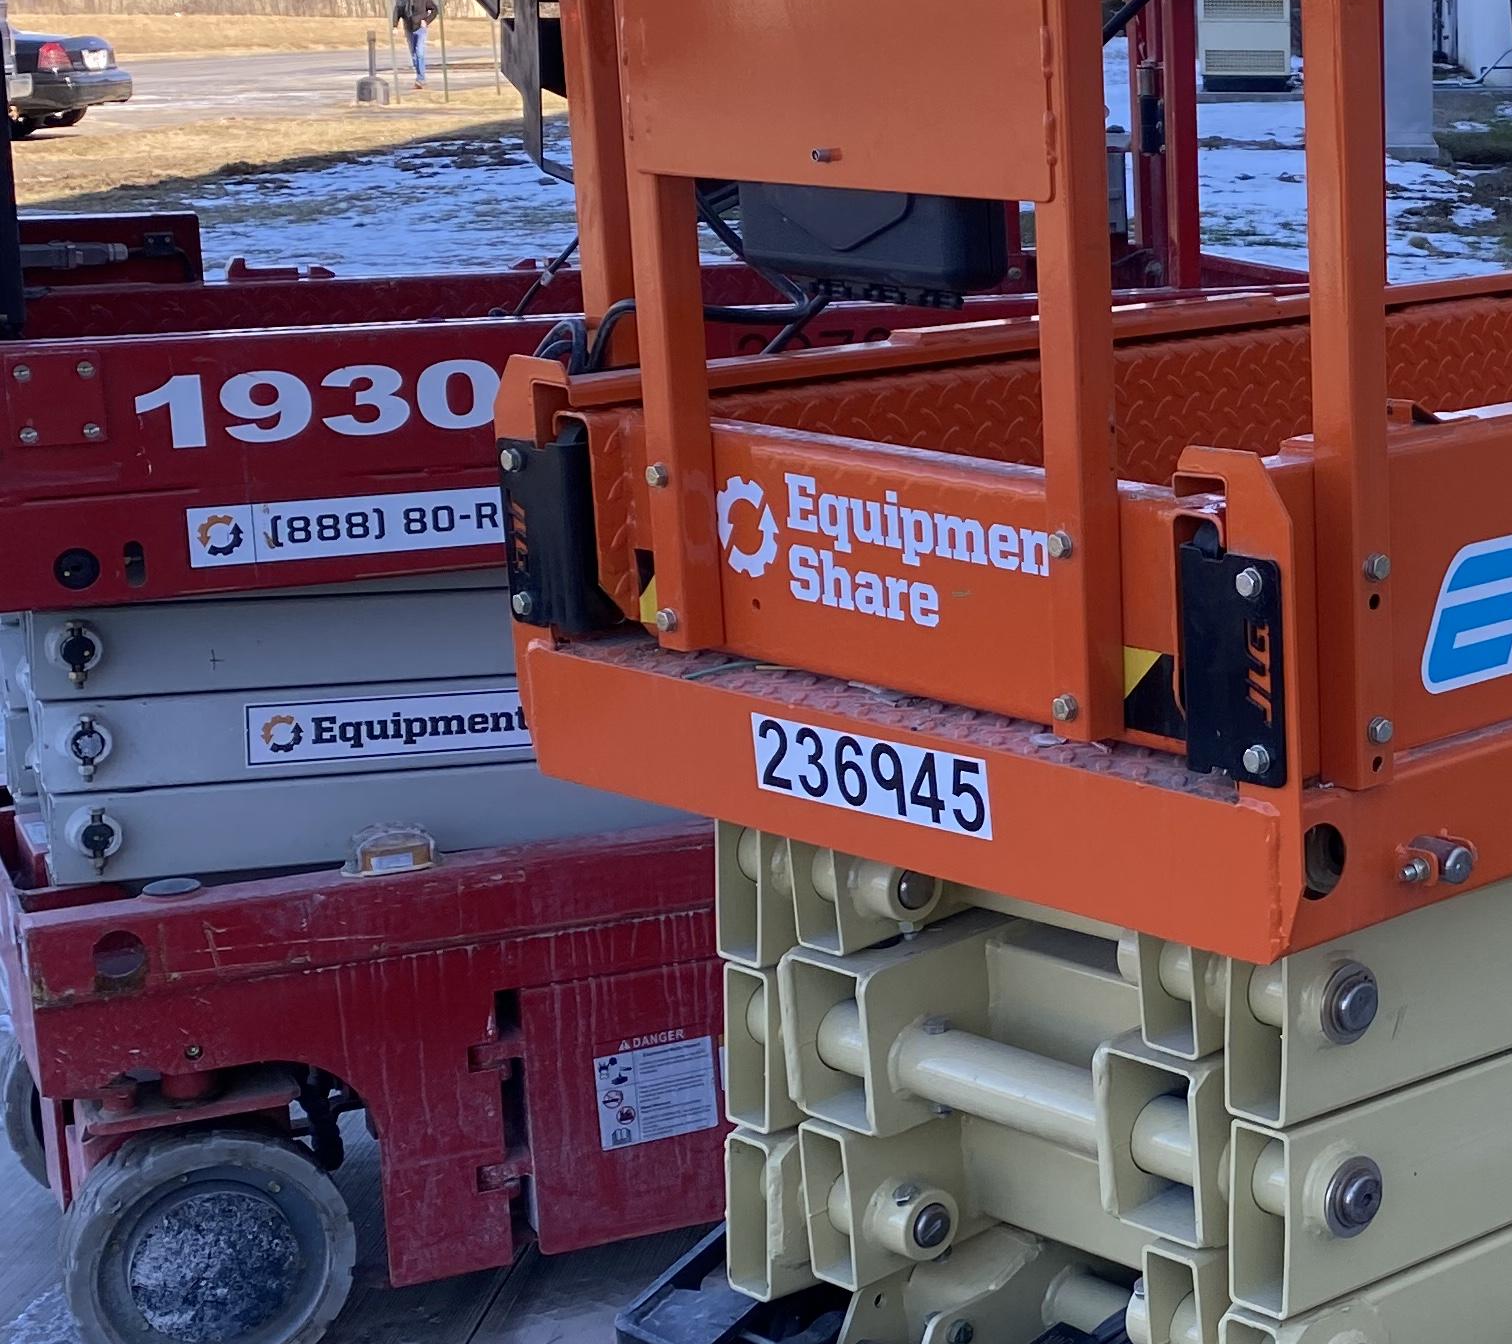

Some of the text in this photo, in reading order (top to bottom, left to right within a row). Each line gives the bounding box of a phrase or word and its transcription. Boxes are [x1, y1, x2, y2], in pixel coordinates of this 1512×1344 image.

[135, 358, 502, 449] 1930
[270, 507, 386, 548] (888)
[788, 544, 940, 628] Share
[758, 719, 986, 832] 236945
[633, 1029, 684, 1048] DANGER
